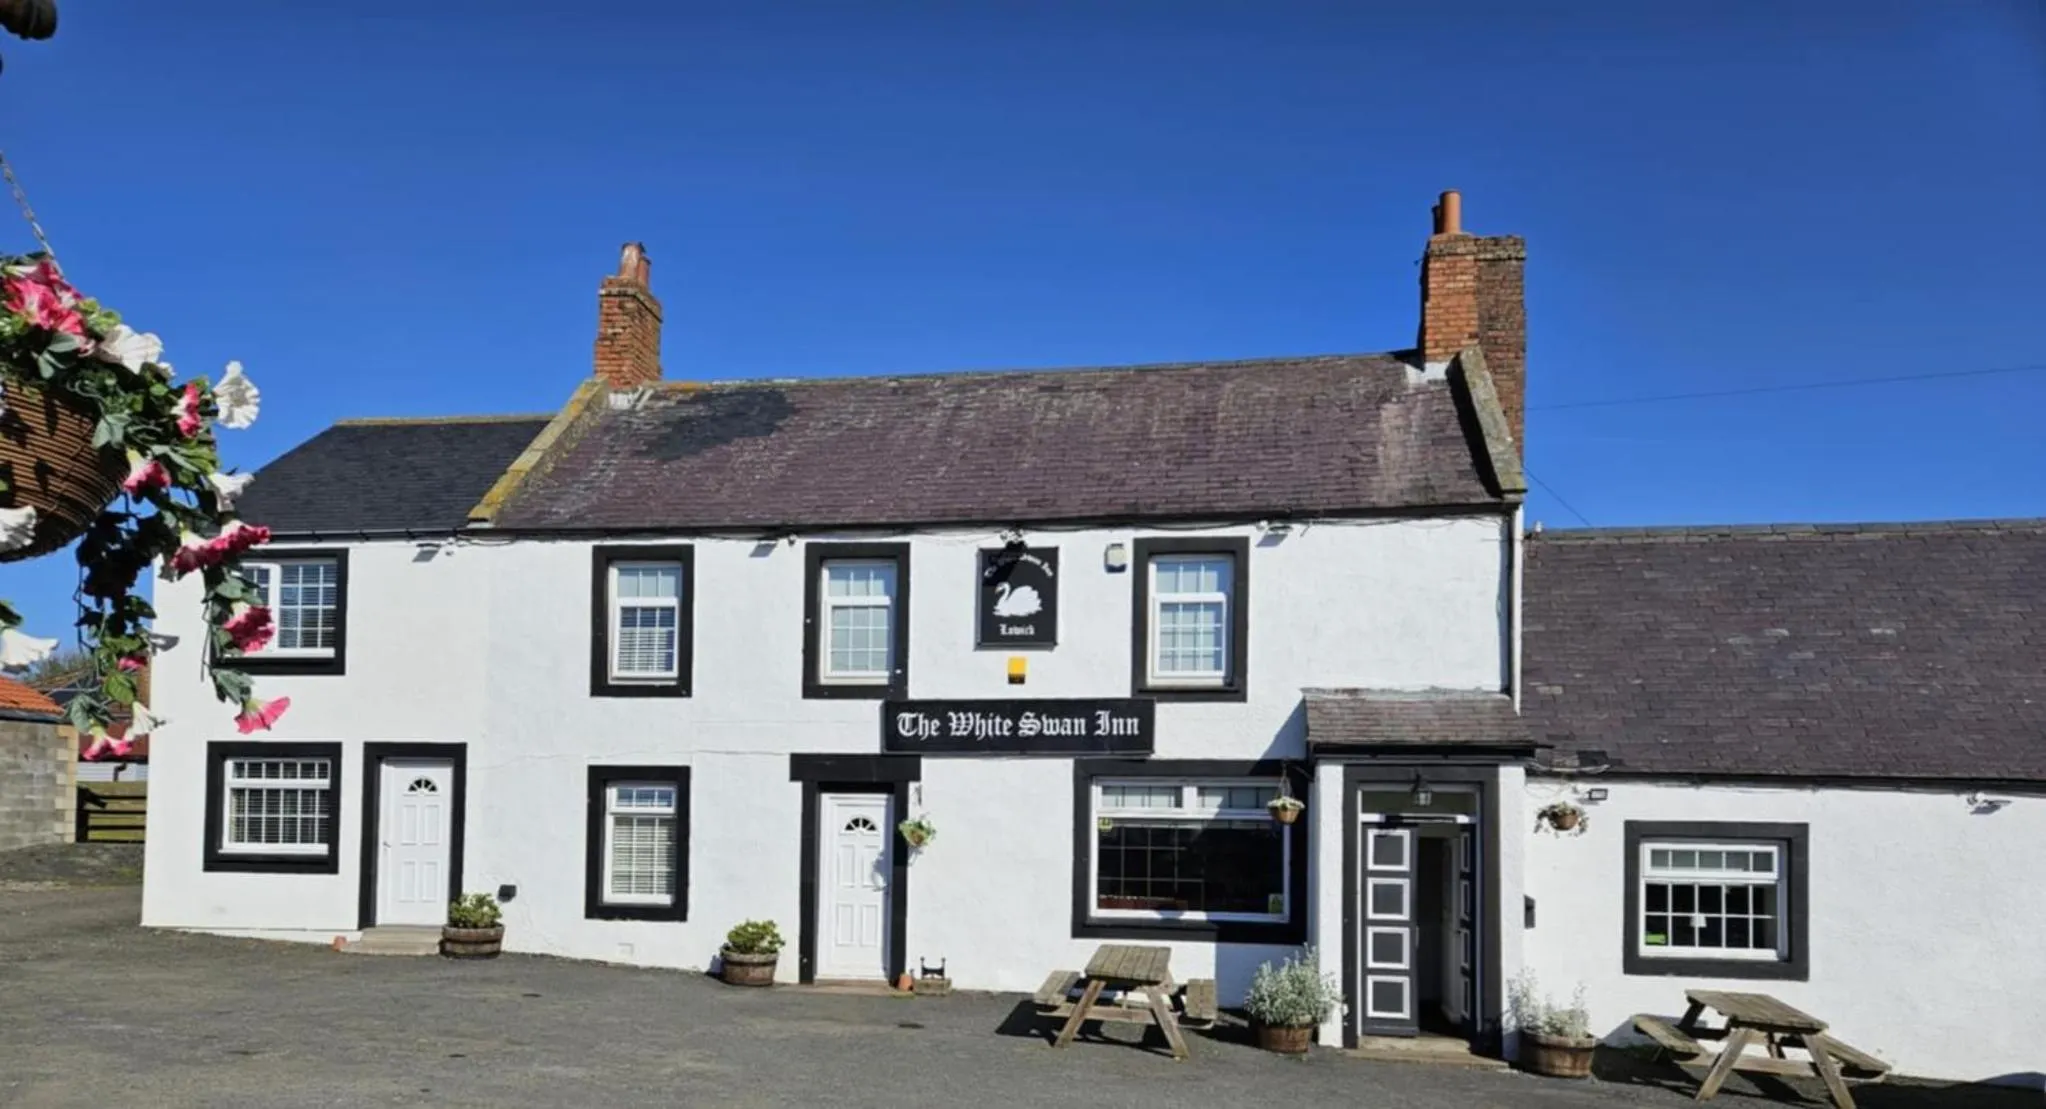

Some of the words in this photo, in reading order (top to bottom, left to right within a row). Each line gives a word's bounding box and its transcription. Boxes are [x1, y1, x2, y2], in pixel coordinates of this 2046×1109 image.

[896, 711, 941, 740] The
[948, 711, 1013, 740] White
[1018, 711, 1086, 736] Swan
[1093, 709, 1140, 736] Inn
